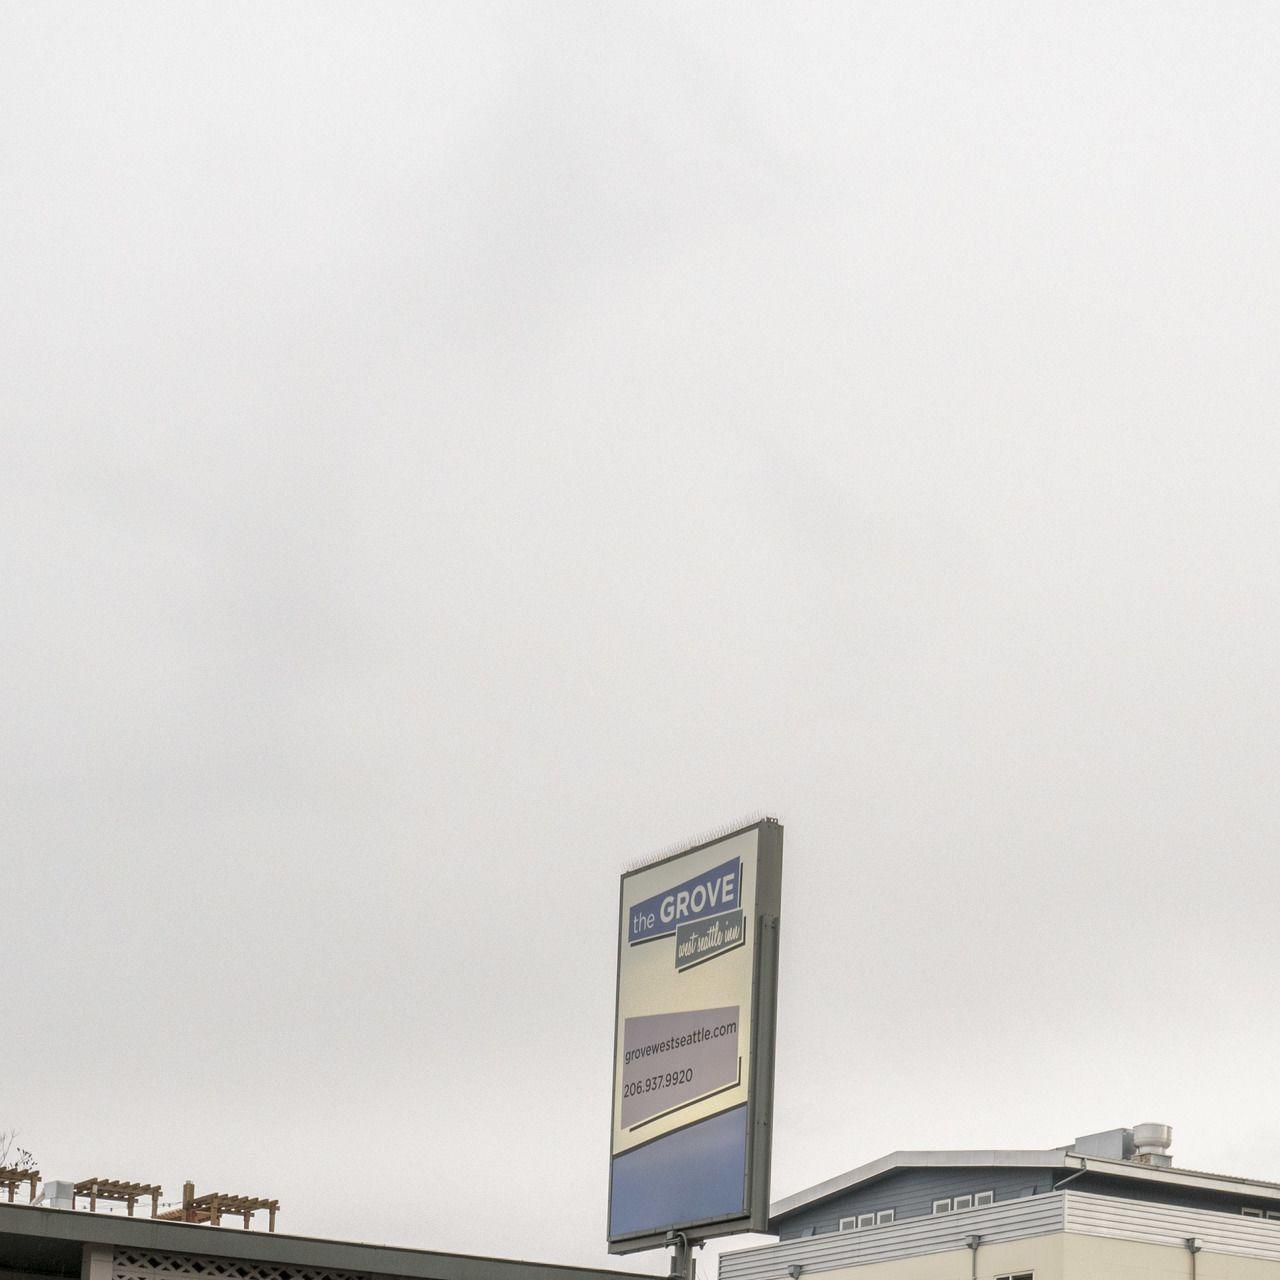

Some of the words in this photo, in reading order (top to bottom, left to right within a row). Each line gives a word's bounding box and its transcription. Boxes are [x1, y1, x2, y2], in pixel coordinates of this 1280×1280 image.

[633, 912, 655, 934] the
[660, 873, 735, 924] GROVE
[678, 931, 699, 958] west
[697, 920, 722, 953] seattle
[625, 1022, 737, 1065] grovewestseattle.com
[623, 1068, 694, 1098] 206.937.9920
